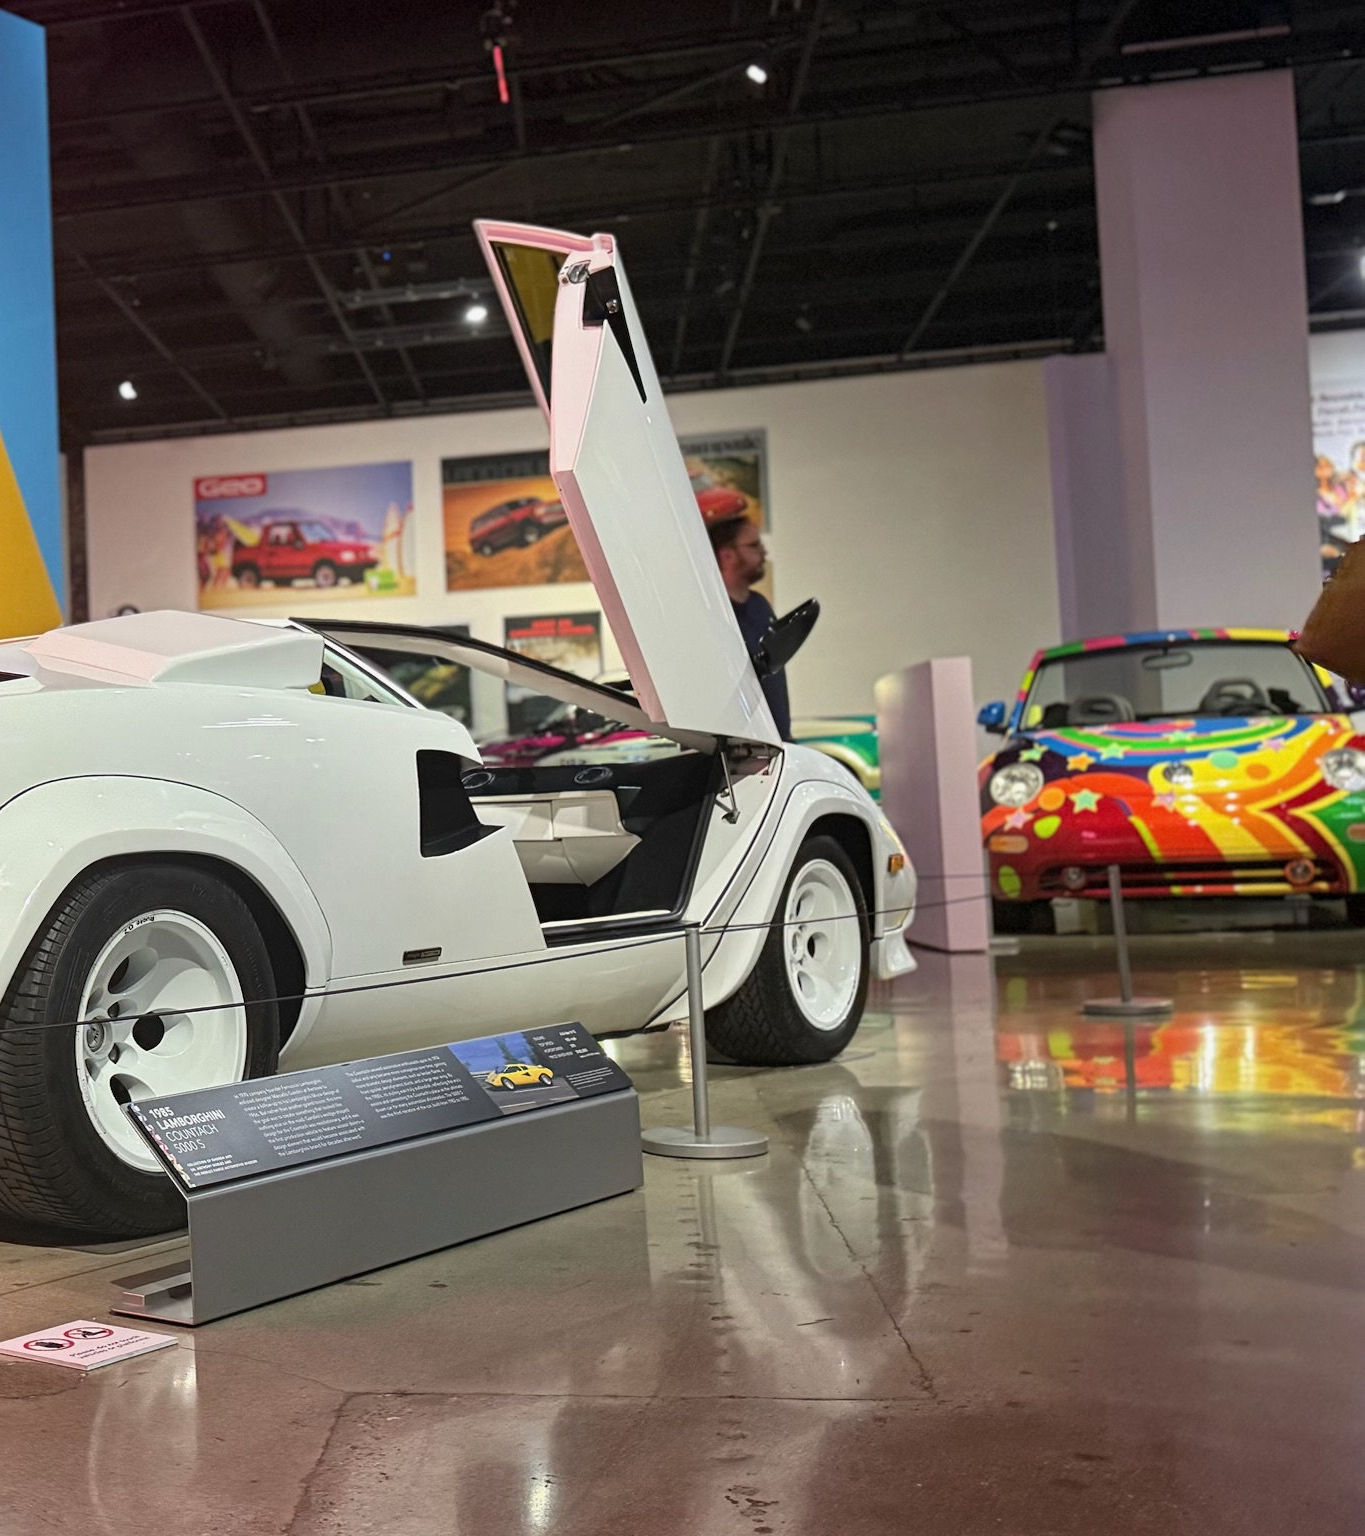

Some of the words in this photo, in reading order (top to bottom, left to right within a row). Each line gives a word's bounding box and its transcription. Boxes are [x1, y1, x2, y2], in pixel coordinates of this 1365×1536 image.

[148, 1106, 174, 1119] 1985
[156, 1109, 226, 1130] LAMBORGHINI
[165, 1123, 219, 1142] COUNTACH
[173, 1140, 199, 1154] 5000
[197, 1139, 206, 1149] S
